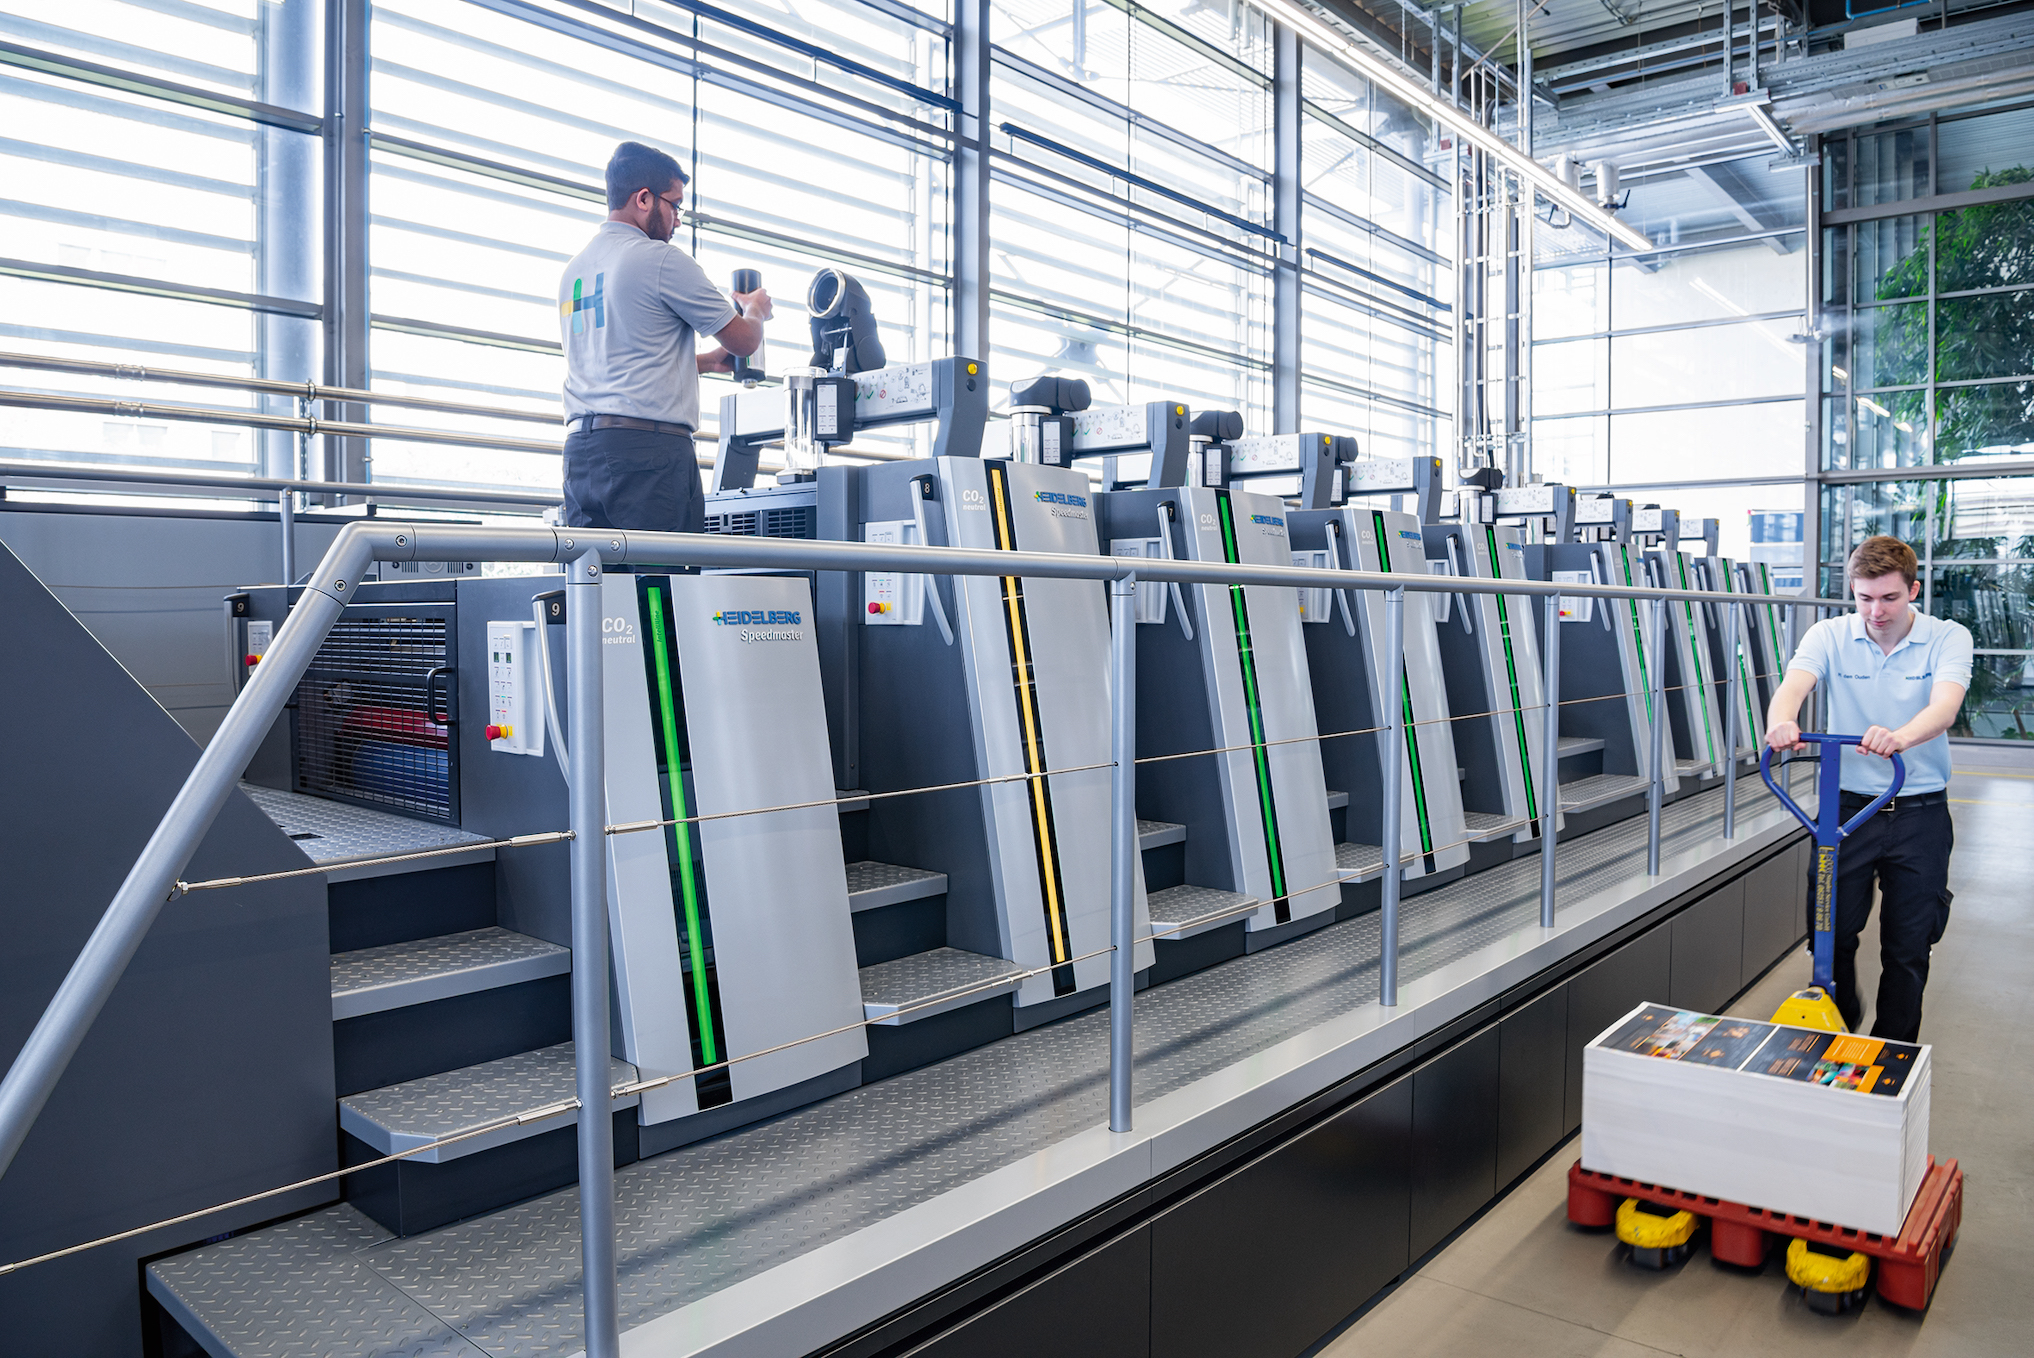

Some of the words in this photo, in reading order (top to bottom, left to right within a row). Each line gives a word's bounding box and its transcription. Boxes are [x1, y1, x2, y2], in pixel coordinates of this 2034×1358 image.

[924, 483, 930, 494] 8
[1034, 491, 1087, 507] HEIDELBERG
[962, 503, 986, 511] neutral
[237, 602, 245, 613] 9
[552, 603, 560, 616] 9
[712, 611, 801, 625] HEIDELBERG
[741, 628, 803, 643] Speedmaster
